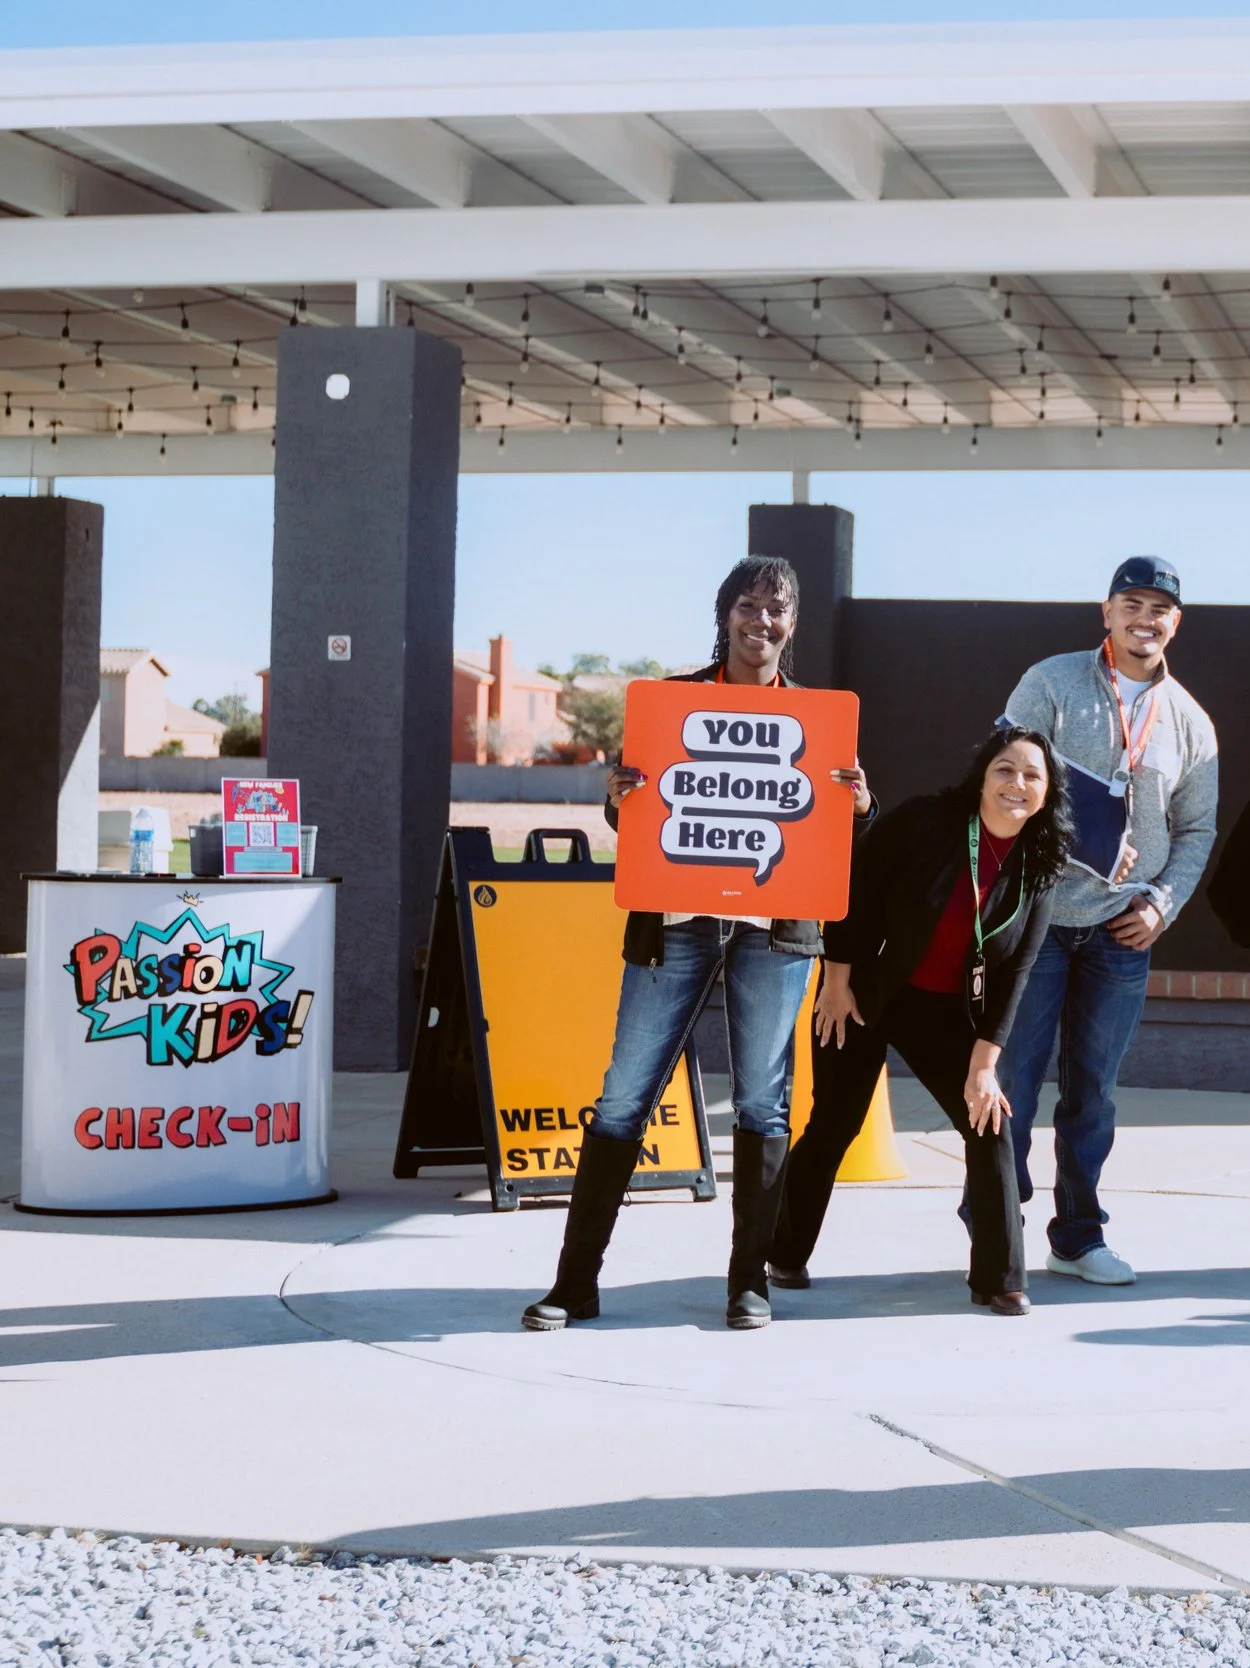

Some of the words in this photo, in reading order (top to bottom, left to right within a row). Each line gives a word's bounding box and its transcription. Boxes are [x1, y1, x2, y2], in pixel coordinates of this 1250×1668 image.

[673, 770, 802, 809] Belong
[234, 813, 288, 822] REGISTRATION
[678, 821, 766, 851] Here
[506, 1143, 660, 1172] STAN
